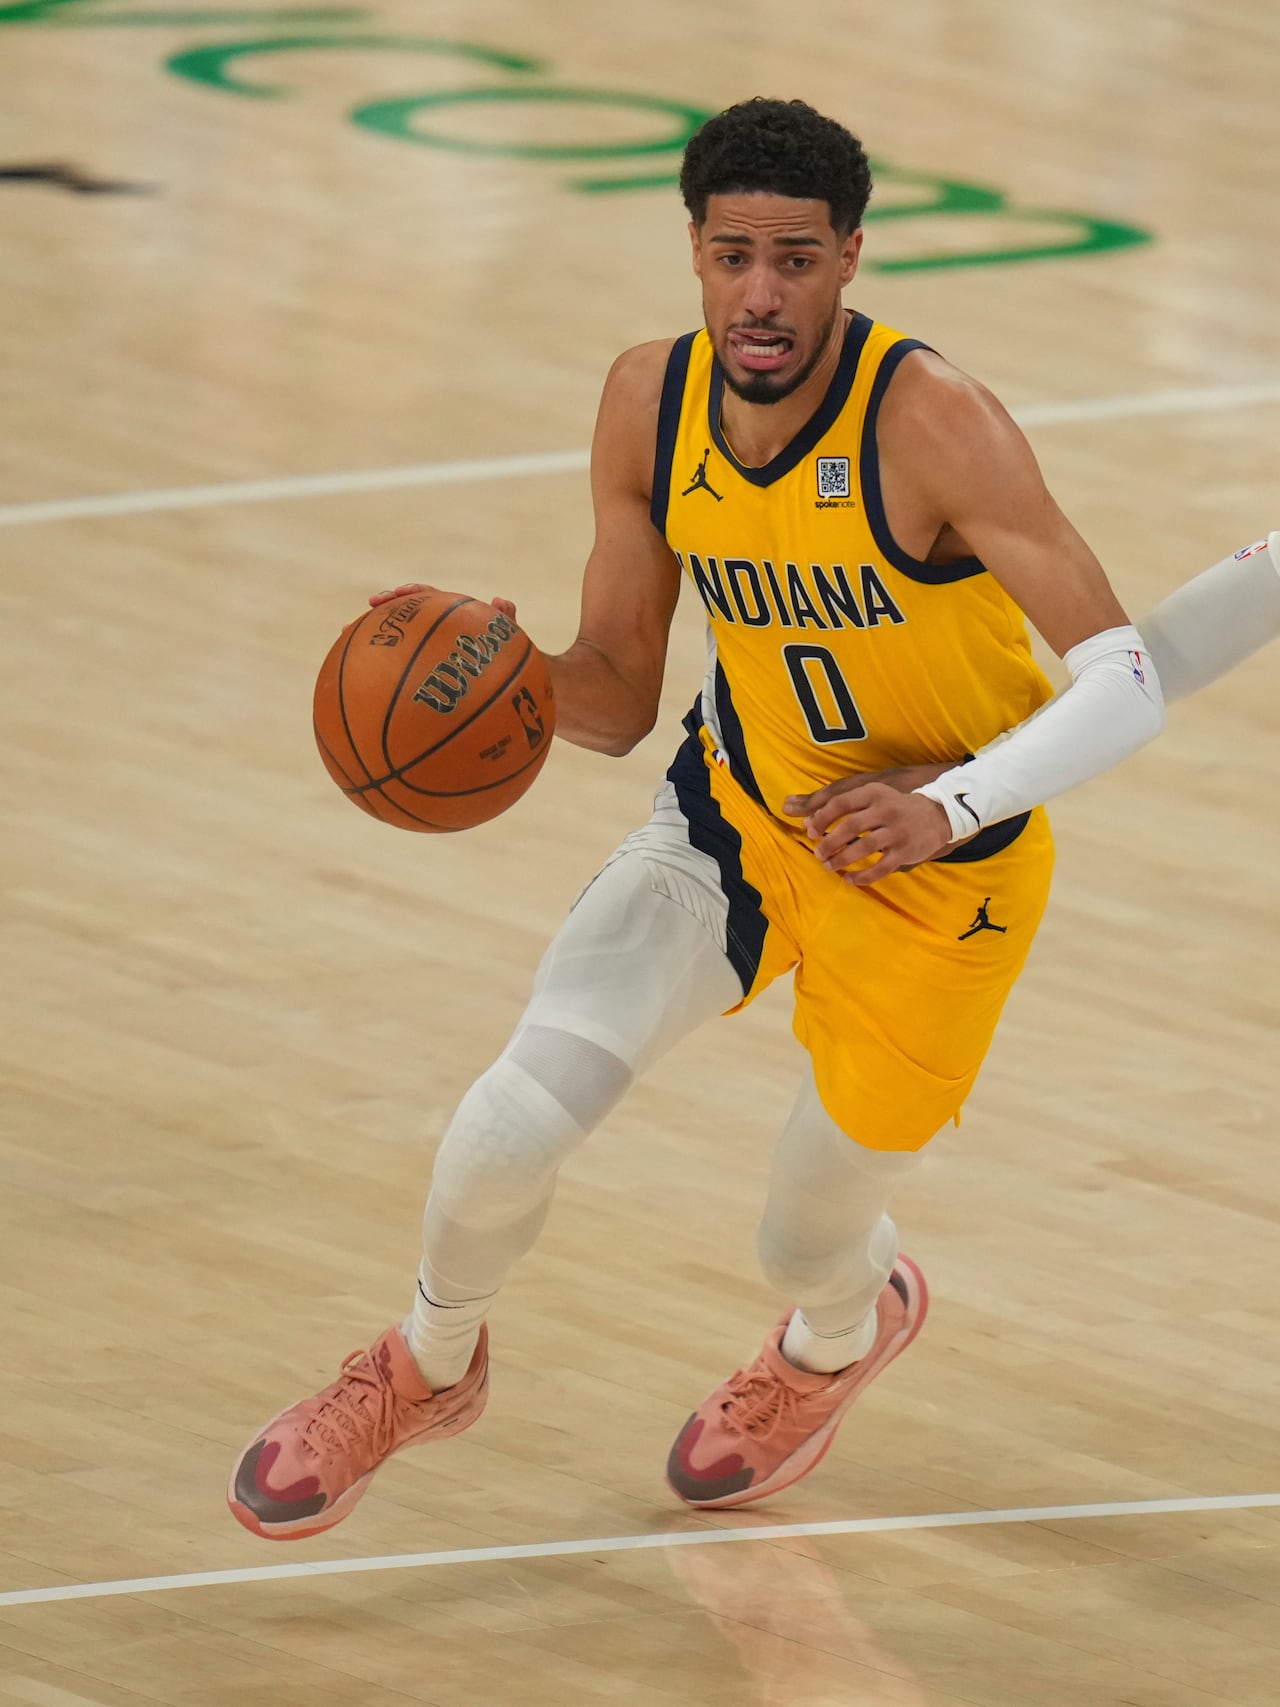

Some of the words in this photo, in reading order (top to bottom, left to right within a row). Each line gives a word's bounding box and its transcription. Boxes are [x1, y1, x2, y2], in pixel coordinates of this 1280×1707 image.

[815, 500, 856, 510] spokenote
[674, 549, 907, 631] NDIANA
[412, 612, 518, 715] Wilson
[781, 643, 868, 745] 0
